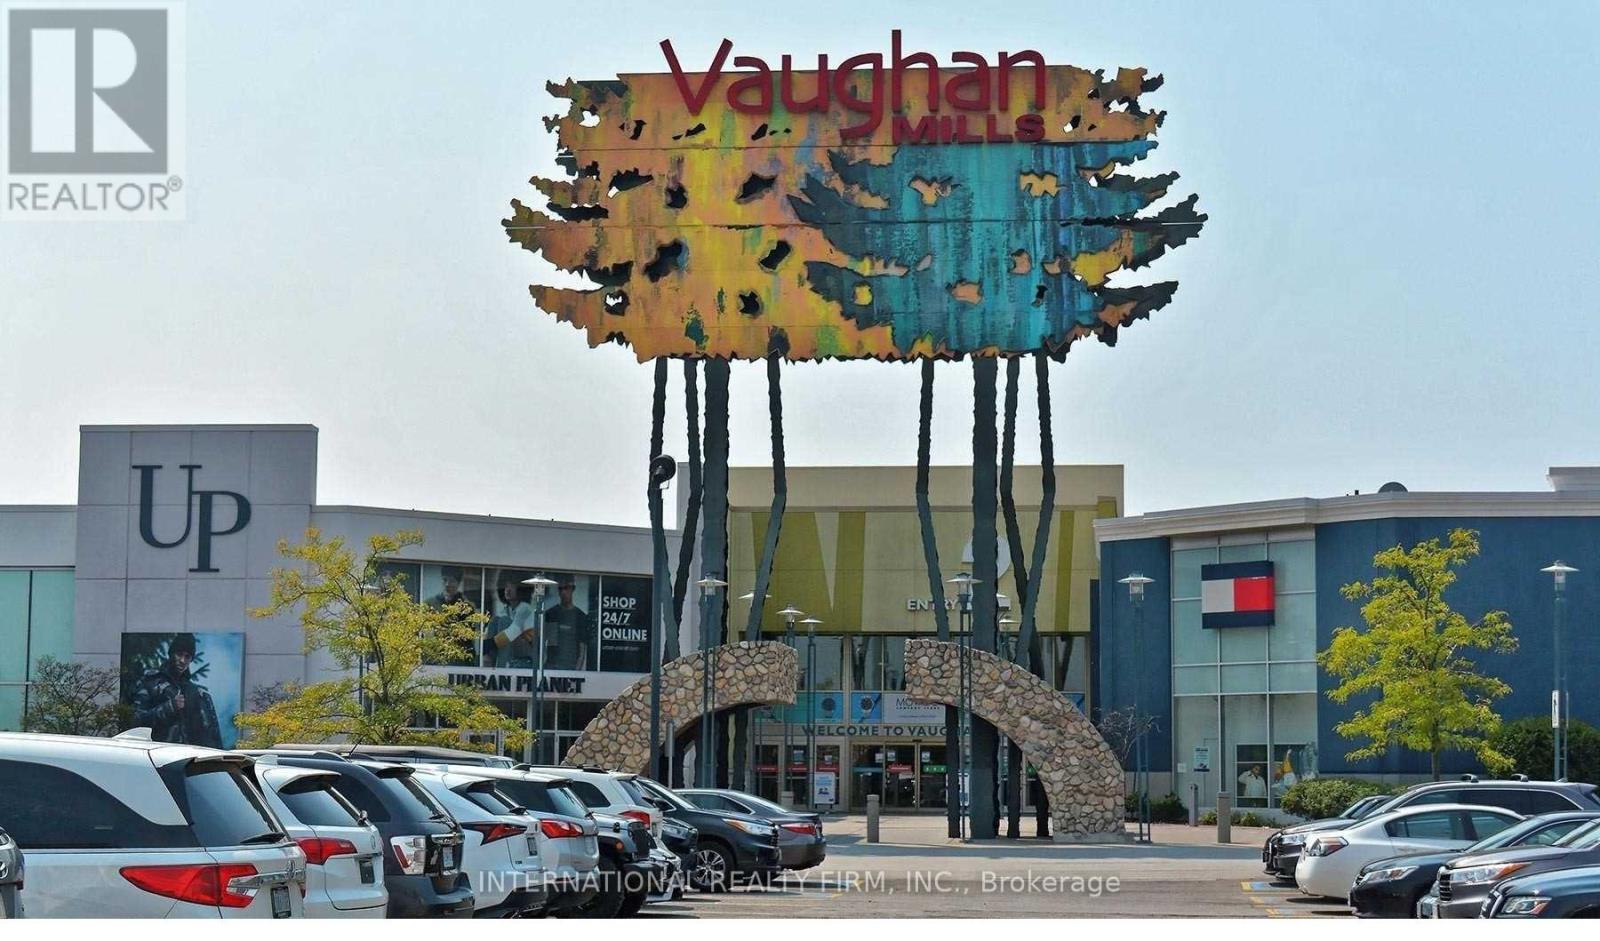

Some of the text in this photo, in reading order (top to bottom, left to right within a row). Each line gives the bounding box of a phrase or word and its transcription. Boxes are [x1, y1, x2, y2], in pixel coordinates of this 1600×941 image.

[659, 29, 1046, 138] Vaughan
[892, 114, 1046, 145] MILLS
[131, 464, 251, 573] UP
[603, 596, 637, 609] SHOP
[602, 611, 631, 626] 24/7
[602, 627, 648, 641] ONLINE
[801, 725, 879, 737] WELCOME
[883, 726, 904, 736] TO
